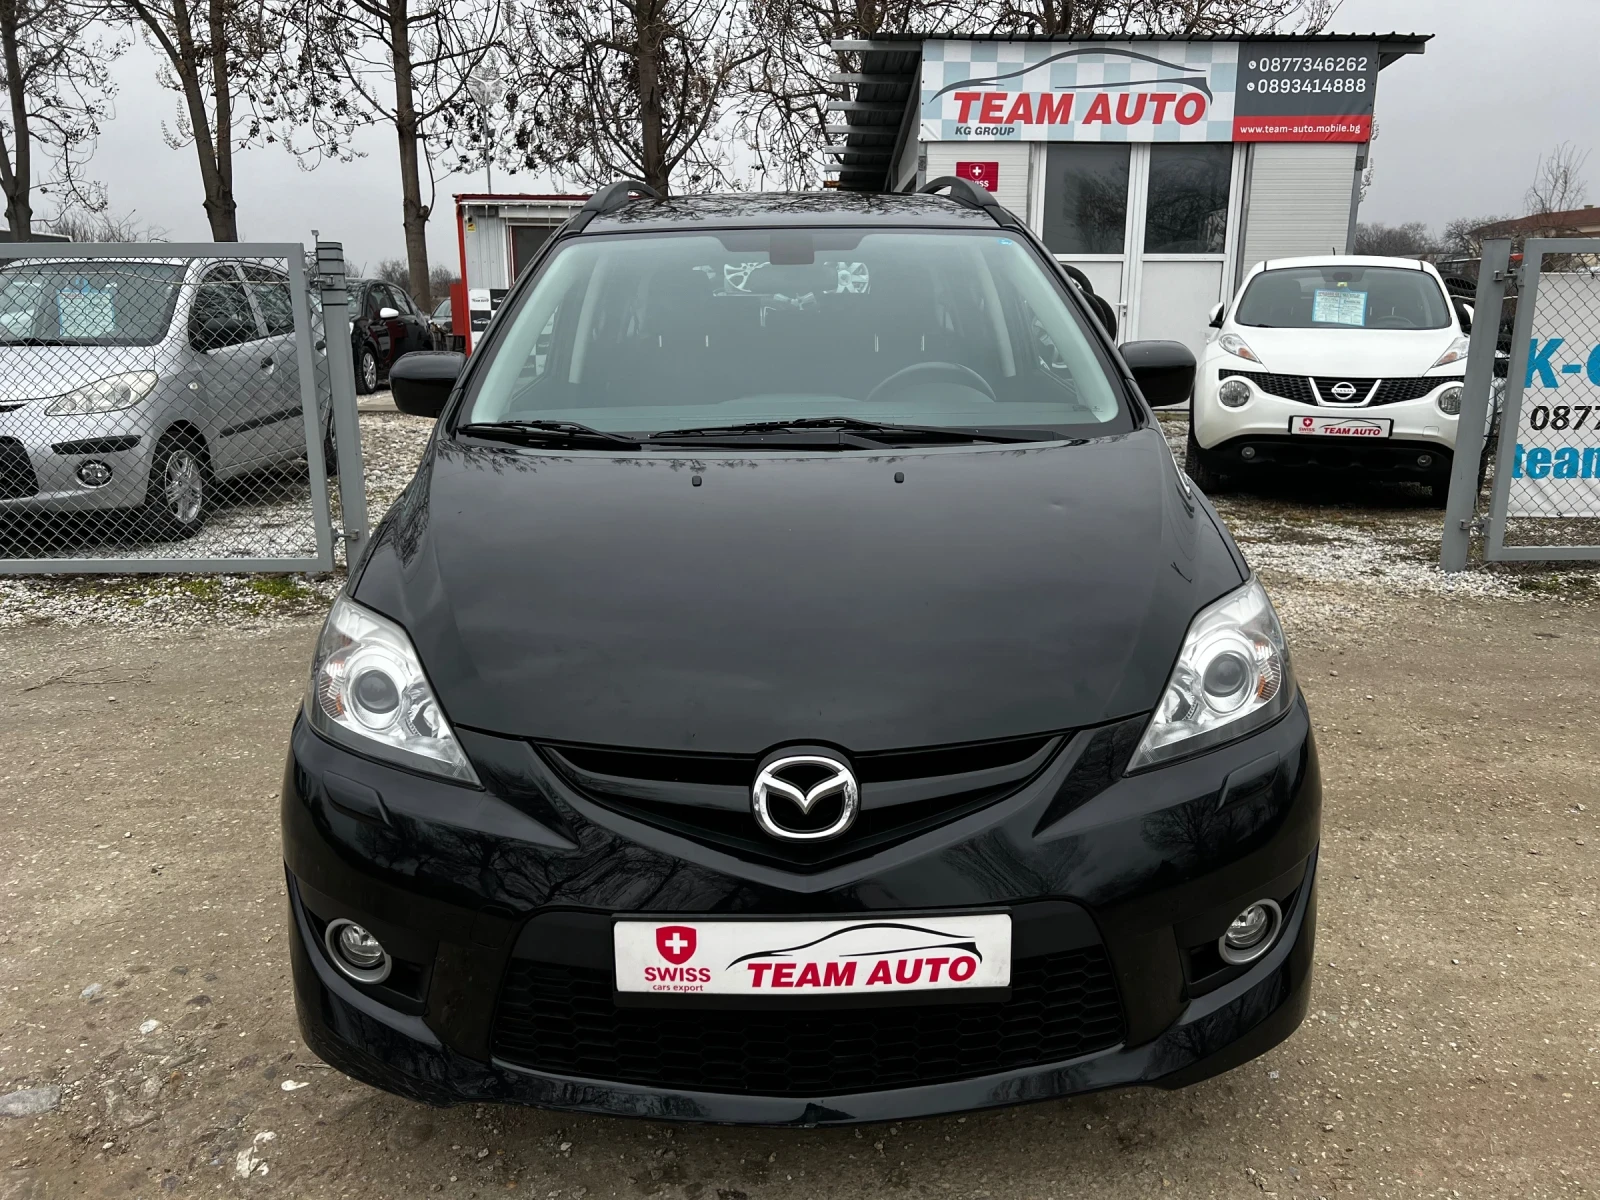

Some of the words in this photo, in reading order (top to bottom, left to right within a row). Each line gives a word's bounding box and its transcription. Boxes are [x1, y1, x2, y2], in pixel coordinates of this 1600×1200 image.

[1258, 57, 1368, 72] 0877346262
[1257, 78, 1367, 94] 0893414888
[953, 92, 1075, 126] TEAM
[1082, 92, 1207, 126] AUTO
[954, 126, 971, 136] KG
[974, 126, 1015, 136] GROUP
[1240, 124, 1361, 134] www.team-auto.mobile.bg
[1323, 427, 1351, 435] TEAM
[1352, 428, 1381, 436] AUTO
[644, 967, 711, 982] SWISS
[747, 961, 857, 988] TEAM
[865, 955, 977, 986] AUTO
[673, 984, 704, 993] export
